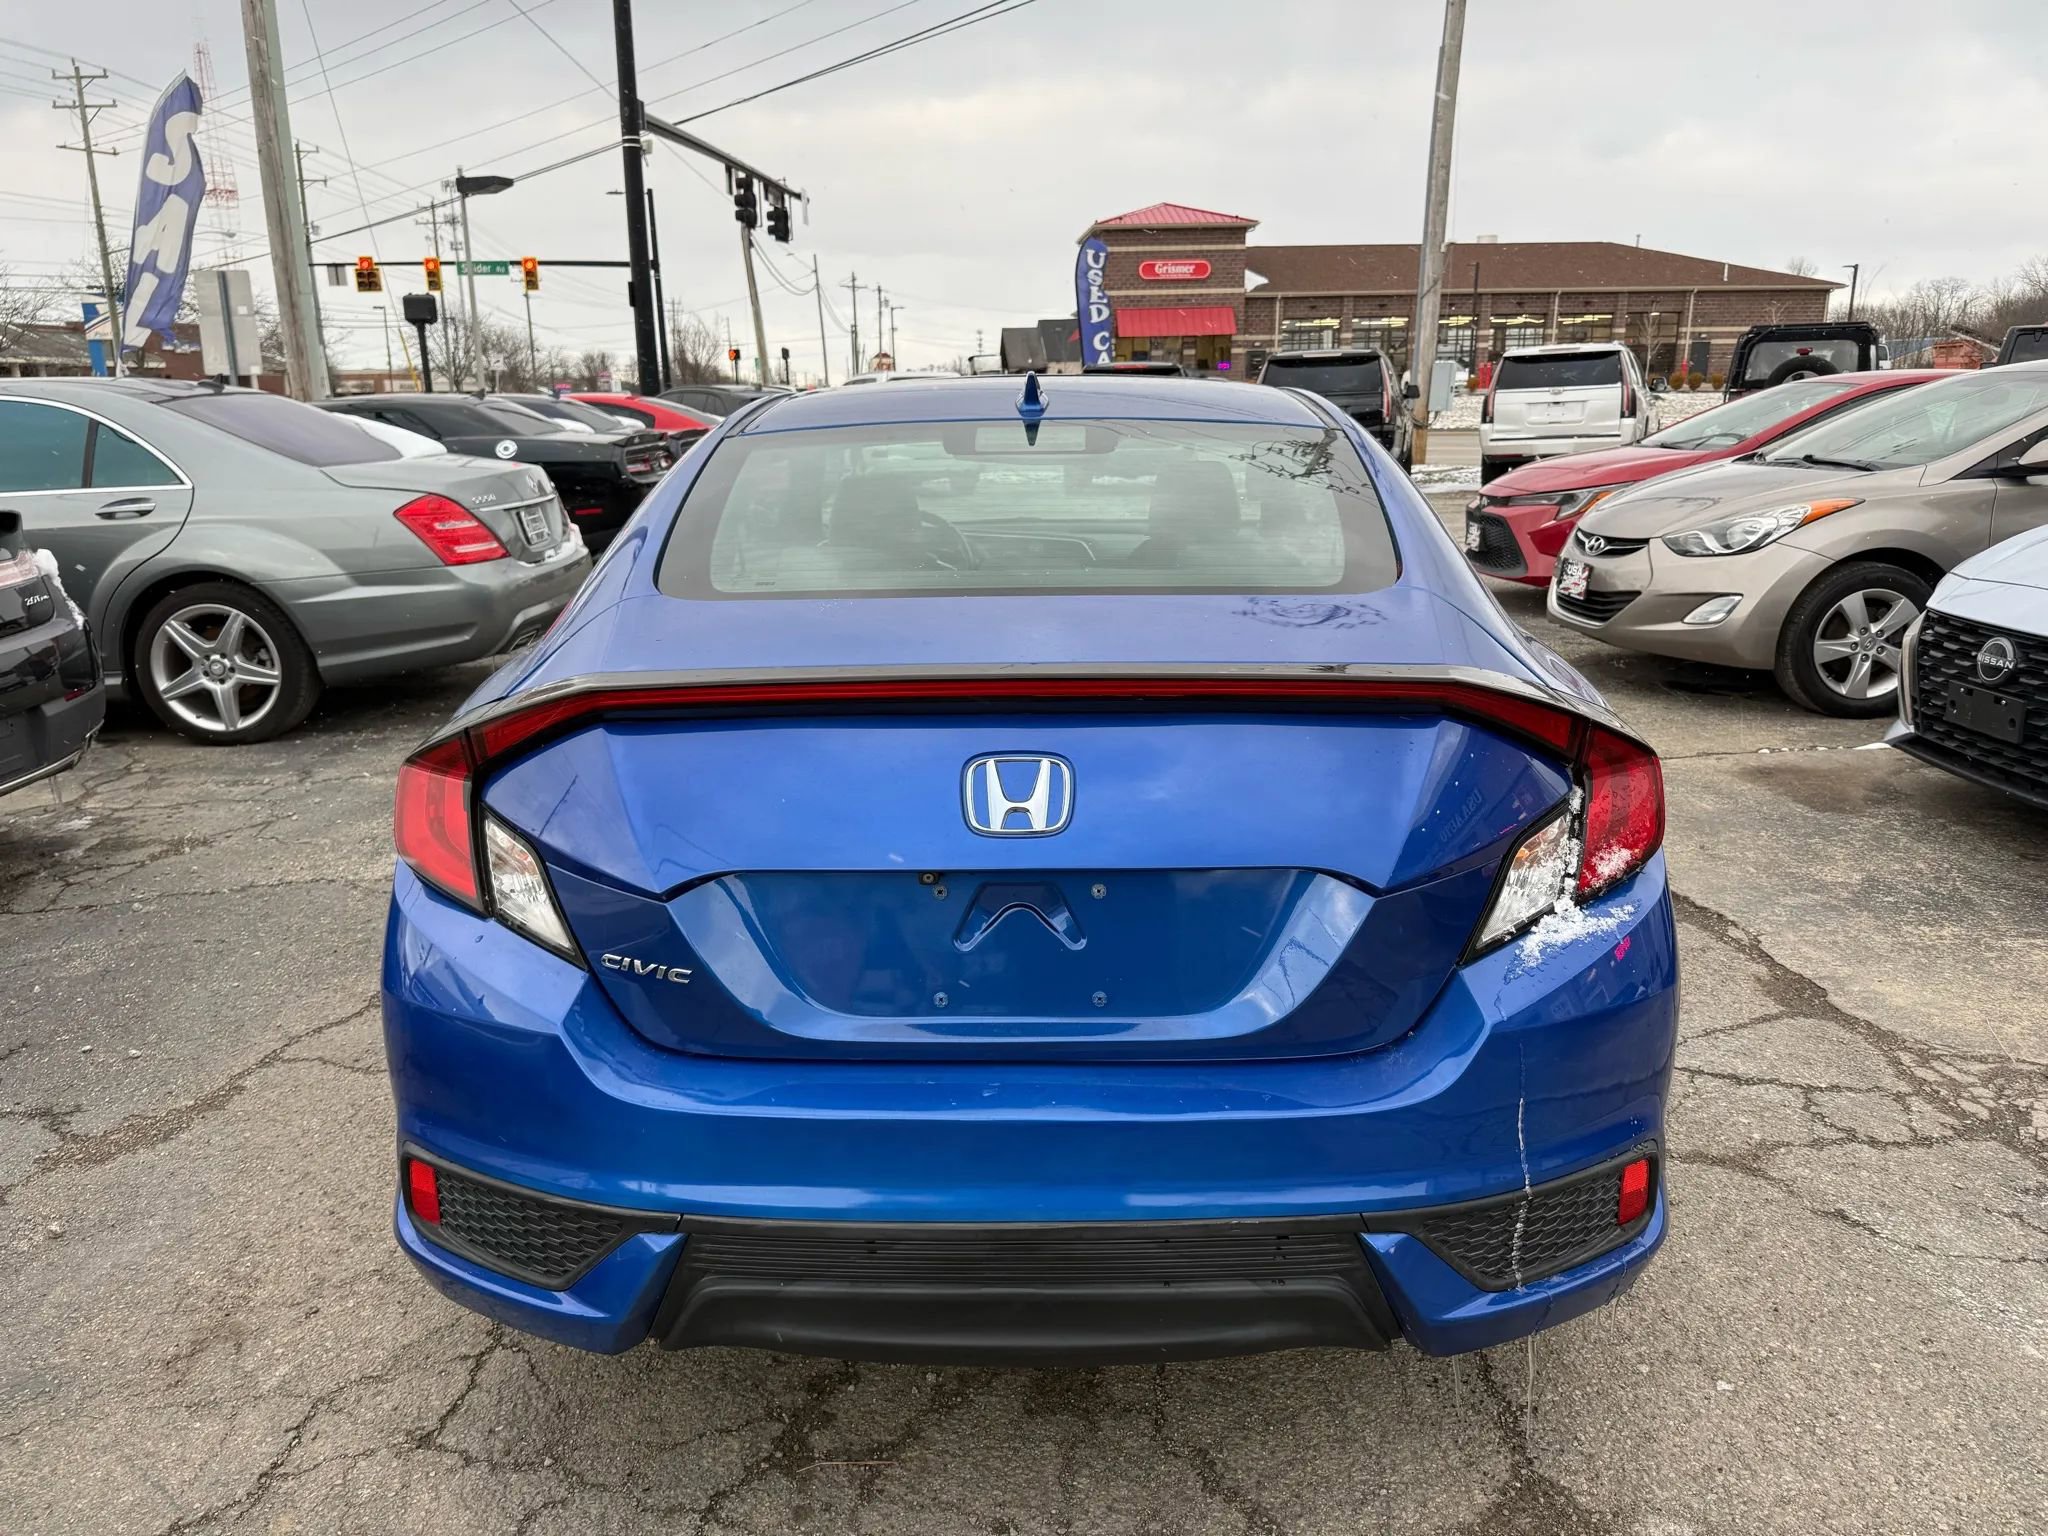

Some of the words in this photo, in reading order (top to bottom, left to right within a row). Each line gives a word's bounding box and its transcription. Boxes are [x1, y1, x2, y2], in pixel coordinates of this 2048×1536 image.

[1154, 263, 1196, 274] Grismer
[1086, 249, 1111, 324] USED
[1979, 652, 2014, 669] NISSAN
[601, 953, 693, 984] CIVIC
